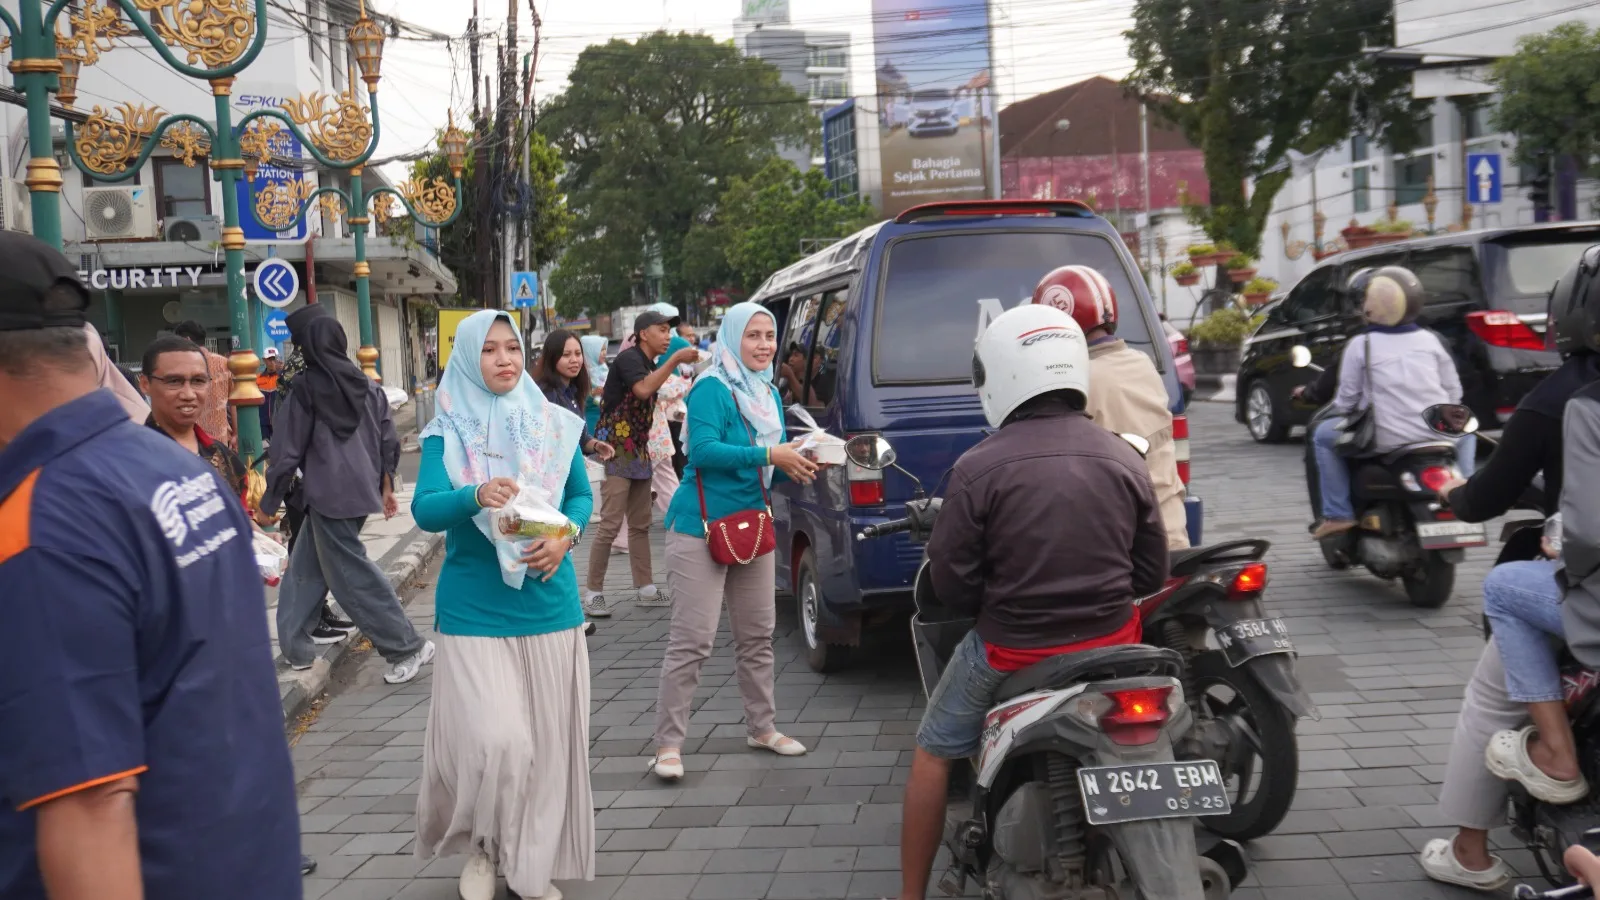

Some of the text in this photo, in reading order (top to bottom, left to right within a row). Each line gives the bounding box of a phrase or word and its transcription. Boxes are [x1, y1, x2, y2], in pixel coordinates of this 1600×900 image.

[912, 156, 961, 169] Bahagia
[893, 168, 981, 184] Sejak Pertama
[1021, 331, 1079, 347] Genio
[1045, 363, 1074, 371] HONDA
[1219, 631, 1233, 649] N
[1234, 621, 1271, 639] 3584
[1083, 765, 1219, 796] N 2642 EBM
